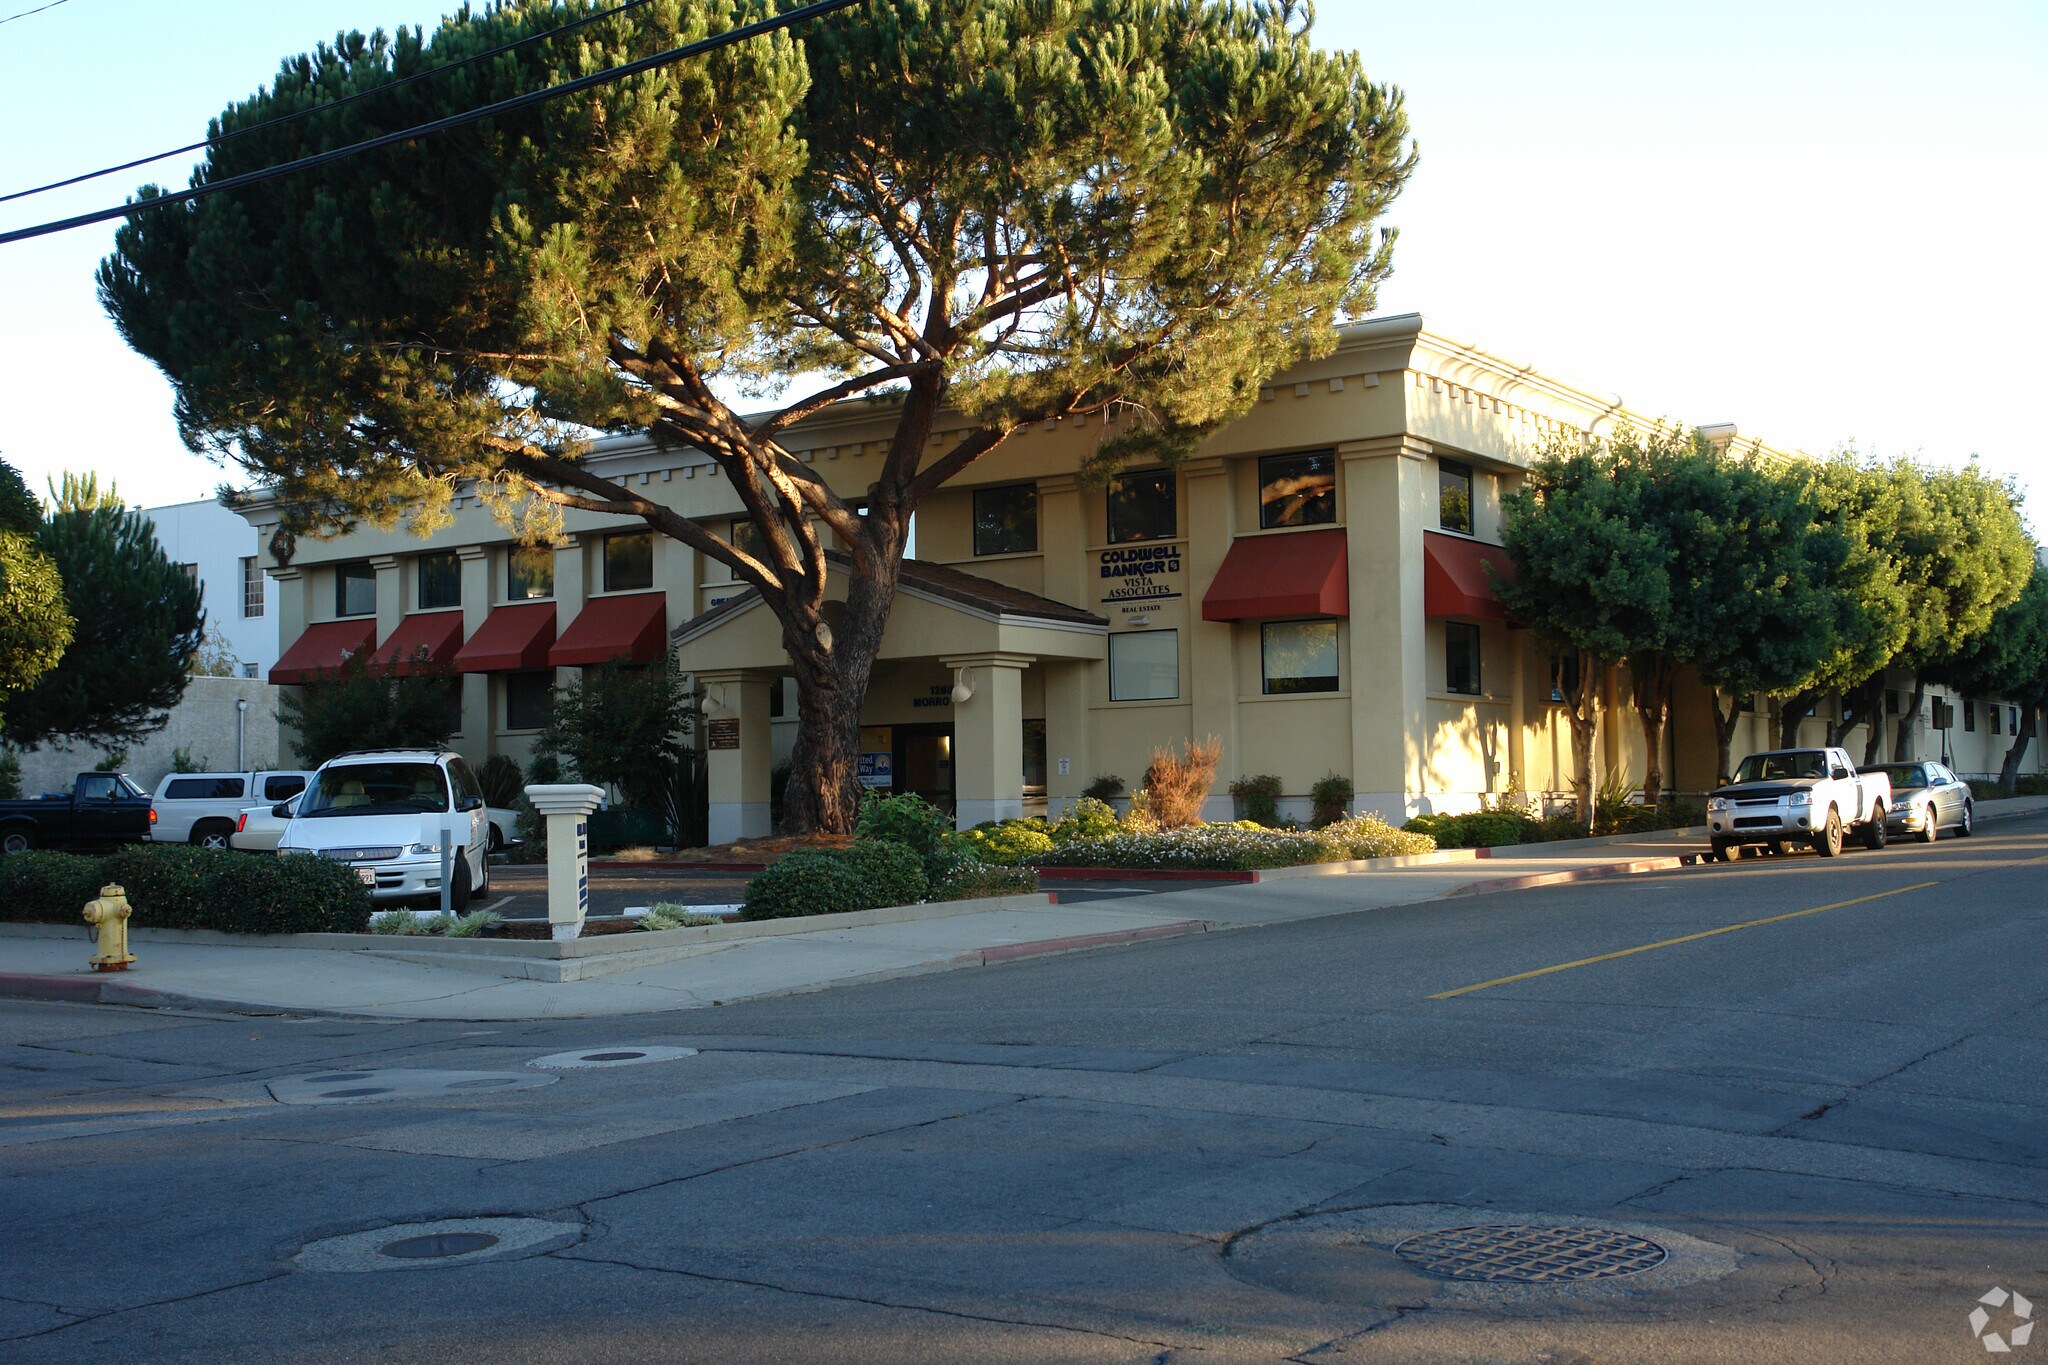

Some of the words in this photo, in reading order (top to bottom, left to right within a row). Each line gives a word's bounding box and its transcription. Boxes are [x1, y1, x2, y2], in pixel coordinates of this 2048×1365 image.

[1124, 577, 1153, 587] VISTA
[1108, 585, 1170, 598] ASSOCIATES
[711, 597, 735, 606] GRE
[1140, 605, 1162, 613] ESTATE
[913, 697, 950, 707] MORRO
[859, 755, 873, 764] ited
[859, 765, 873, 774] Way
